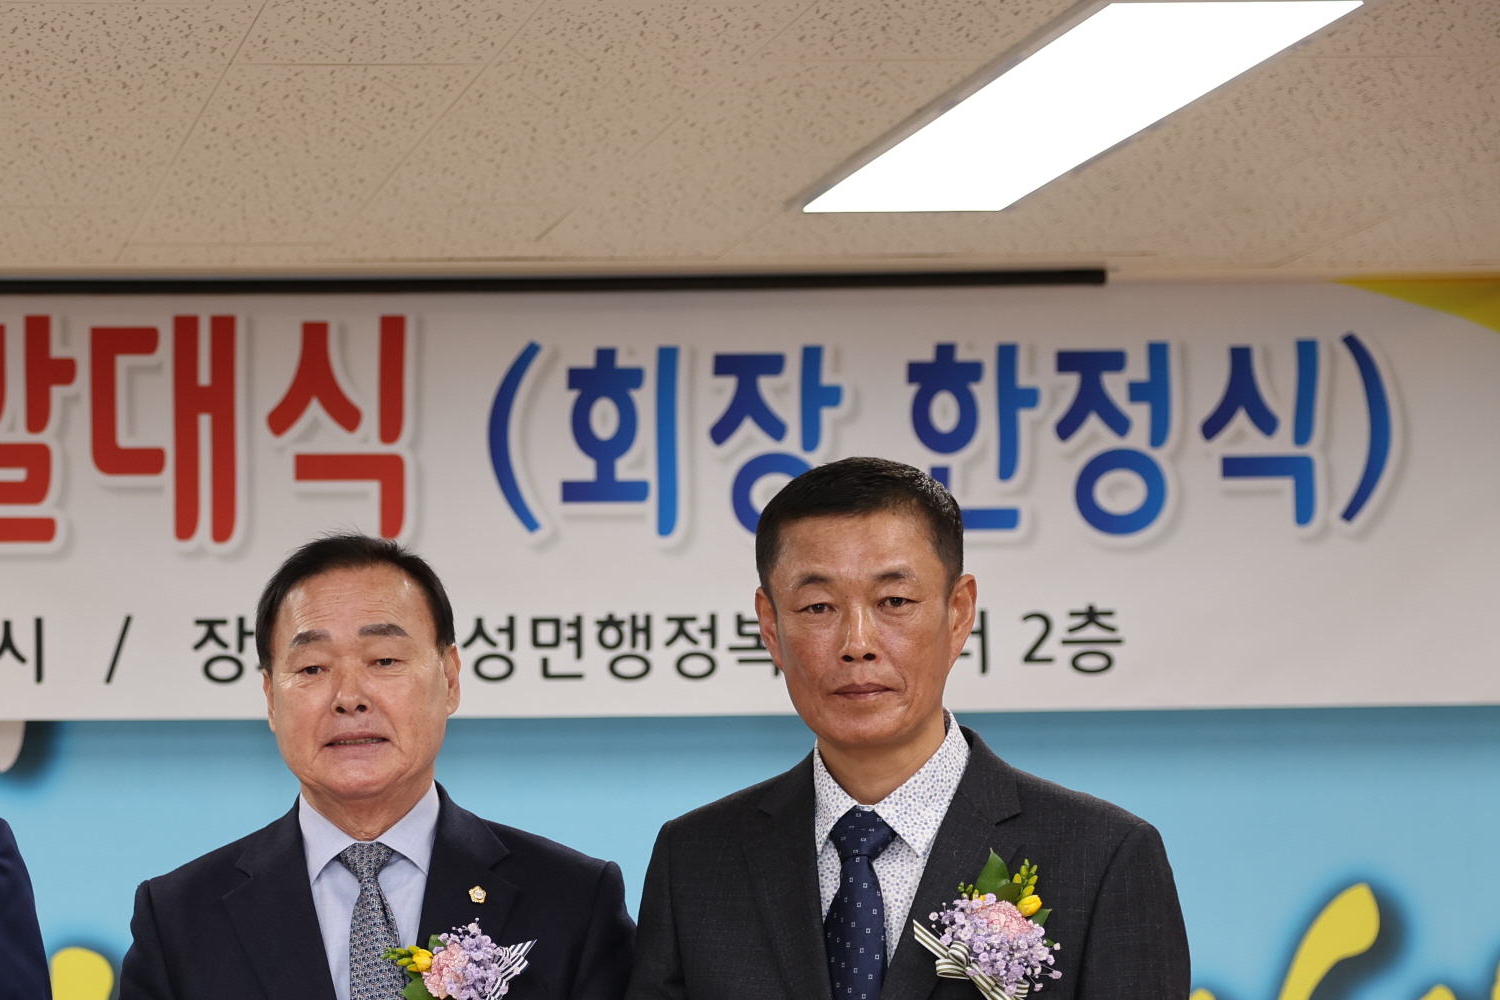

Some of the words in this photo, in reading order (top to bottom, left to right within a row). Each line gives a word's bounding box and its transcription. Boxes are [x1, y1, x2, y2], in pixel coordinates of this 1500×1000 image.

[487, 341, 843, 537] (회장
[907, 332, 1392, 535] 한정식)
[193, 616, 263, 685] 장
[1021, 605, 1124, 675] 2층
